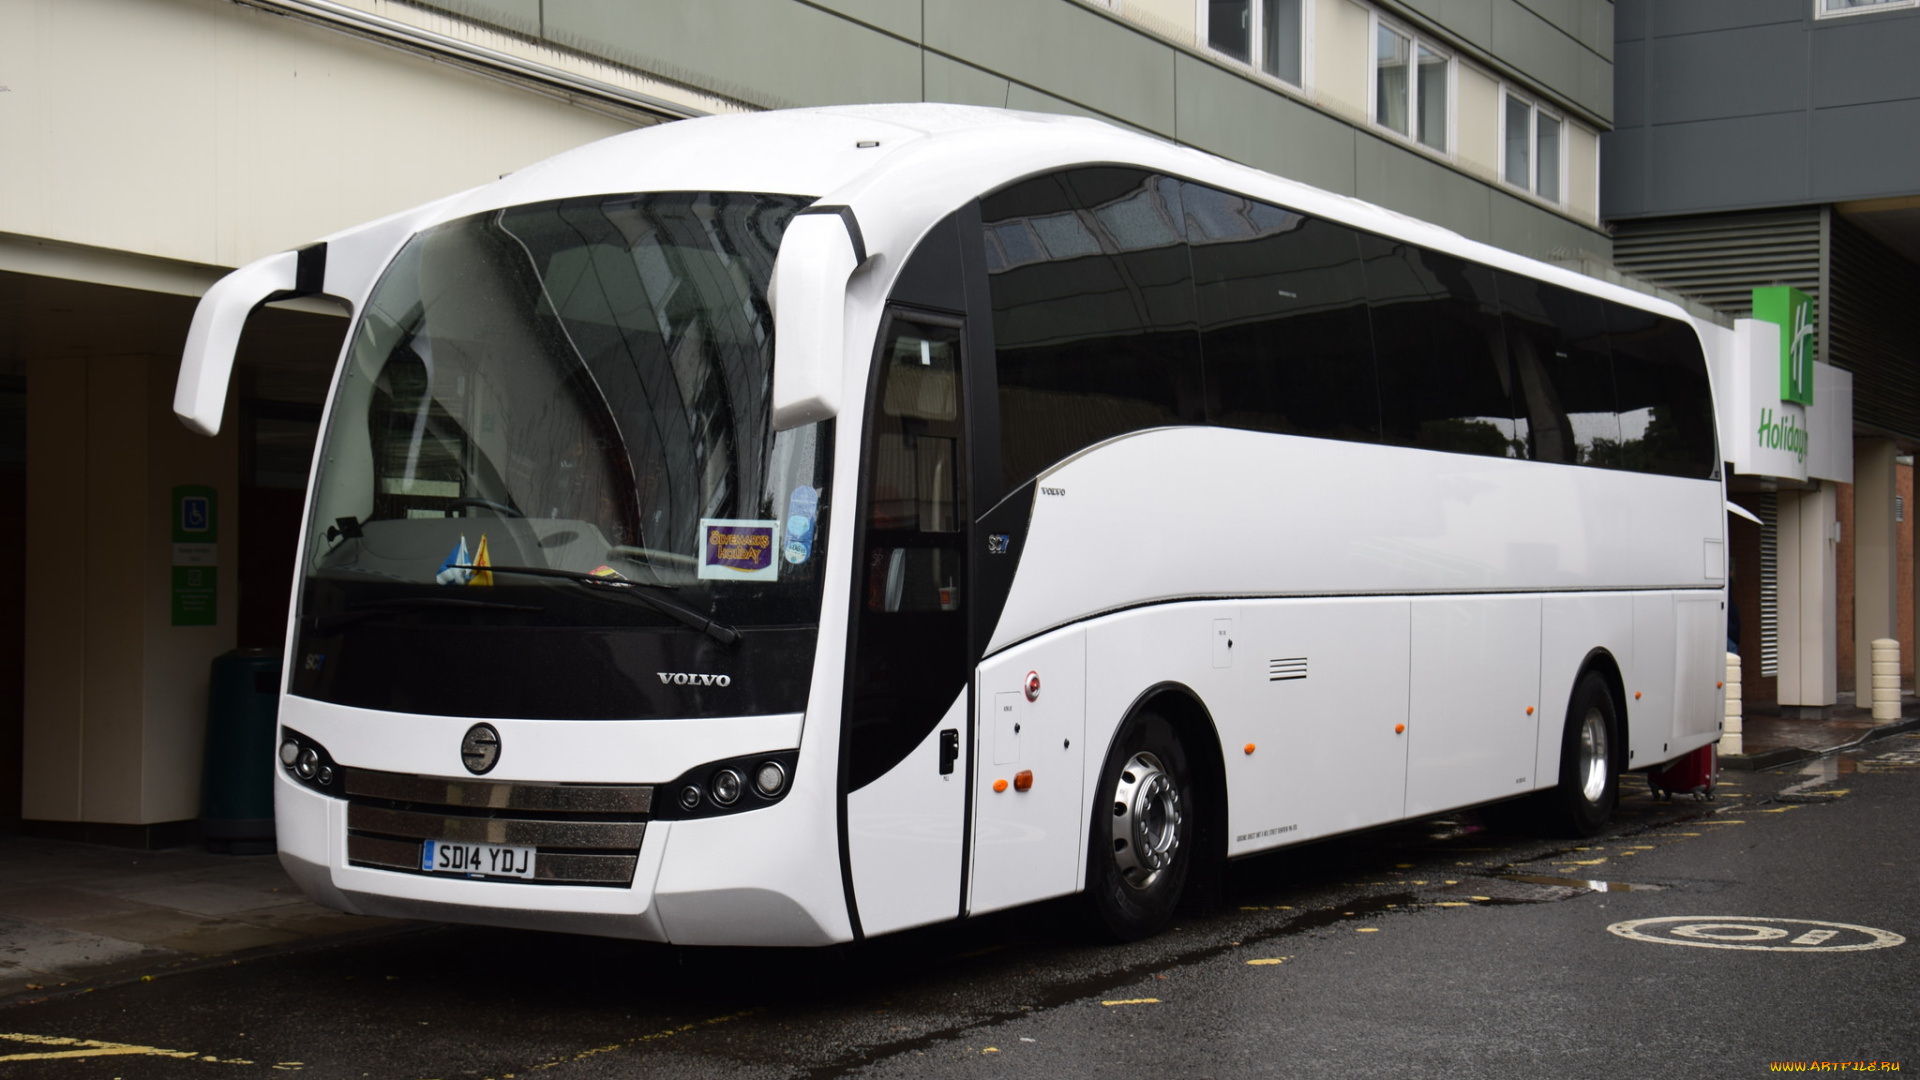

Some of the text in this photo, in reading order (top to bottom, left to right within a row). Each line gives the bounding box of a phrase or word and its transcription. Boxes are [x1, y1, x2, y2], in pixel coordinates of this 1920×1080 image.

[1758, 408, 1805, 463] Holiday
[1041, 487, 1066, 496] VOLVO
[988, 534, 1009, 553] SC7
[717, 544, 761, 564] HOLIDAY
[657, 672, 731, 687] VOLVO
[439, 845, 528, 873] SD14 YDJ
